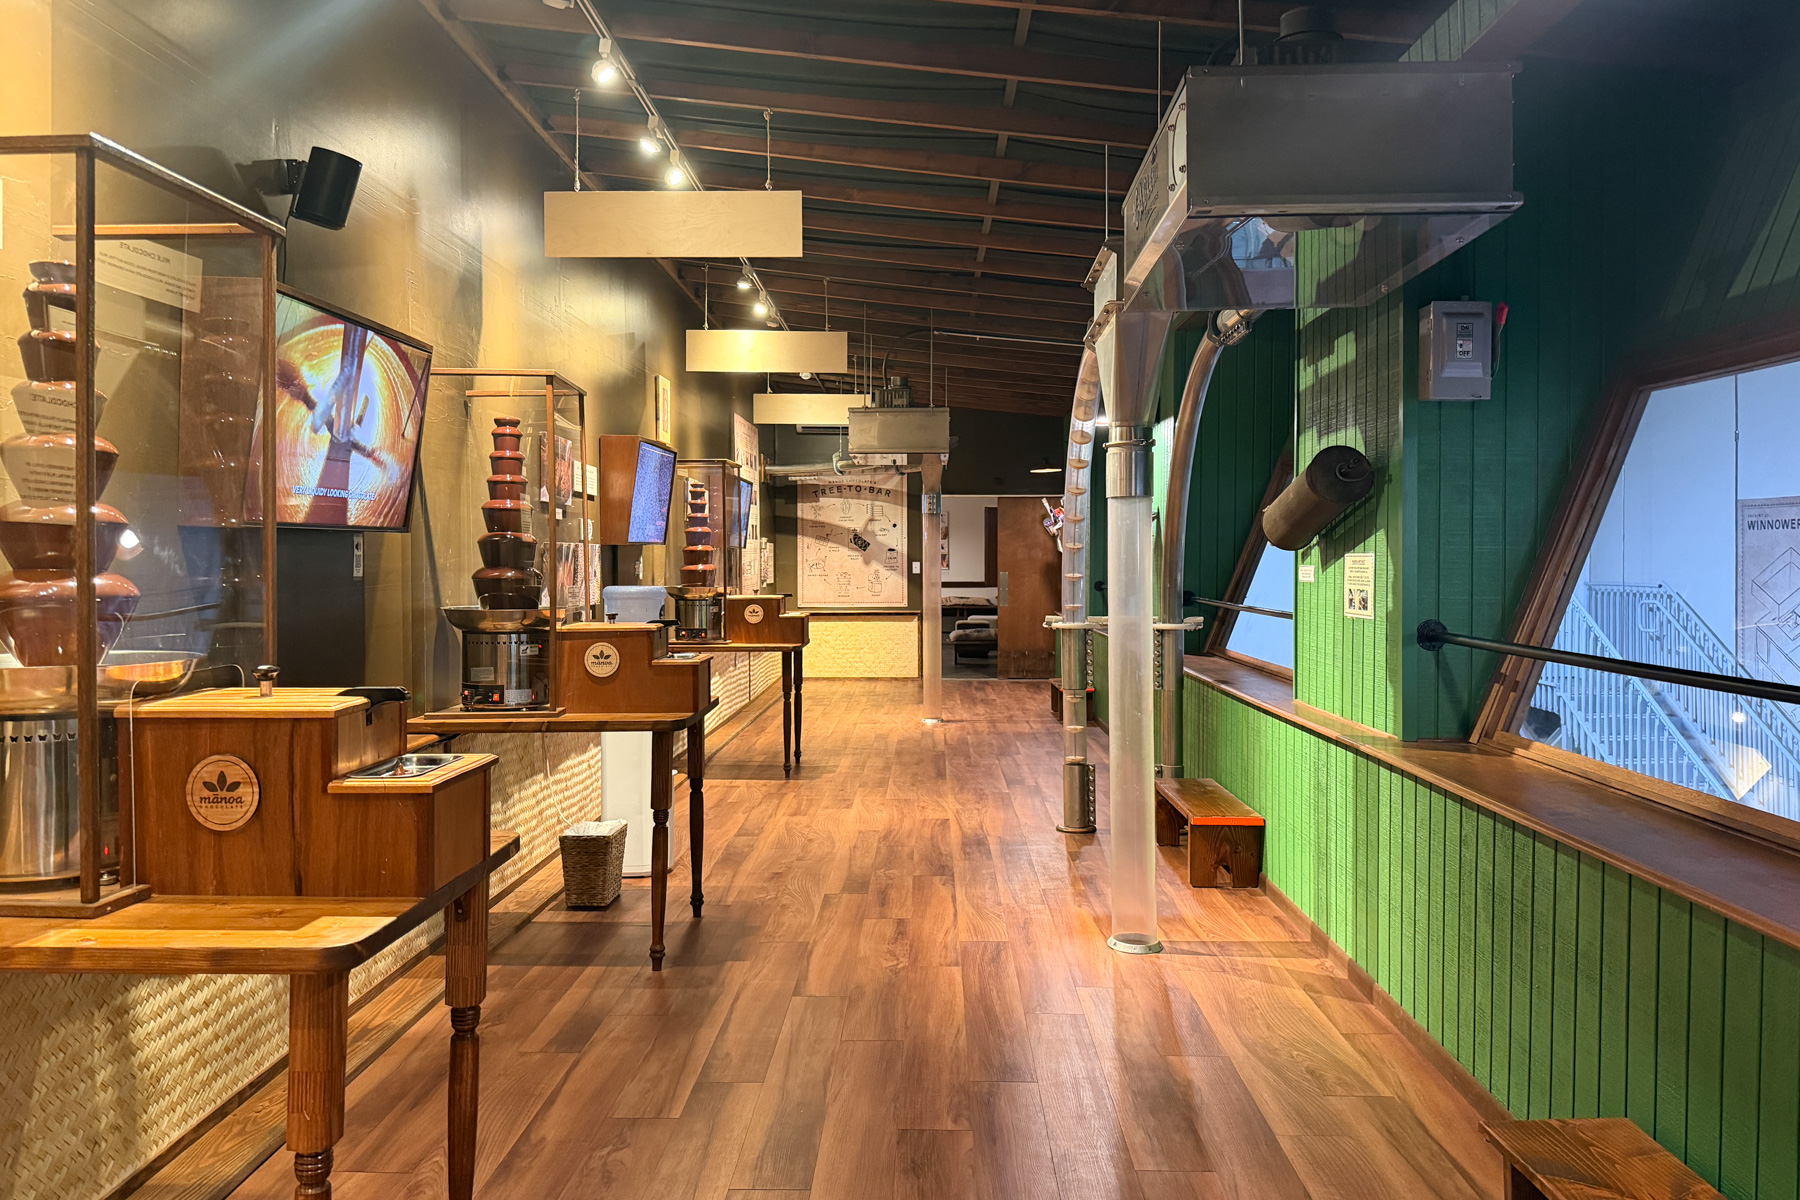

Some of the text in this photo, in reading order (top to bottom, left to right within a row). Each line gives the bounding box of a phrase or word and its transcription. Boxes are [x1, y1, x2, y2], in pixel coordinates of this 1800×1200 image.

[292, 484, 376, 501] VERY LIQUIDY LOOKING CHOCOLATE
[199, 794, 245, 805] mānoa
